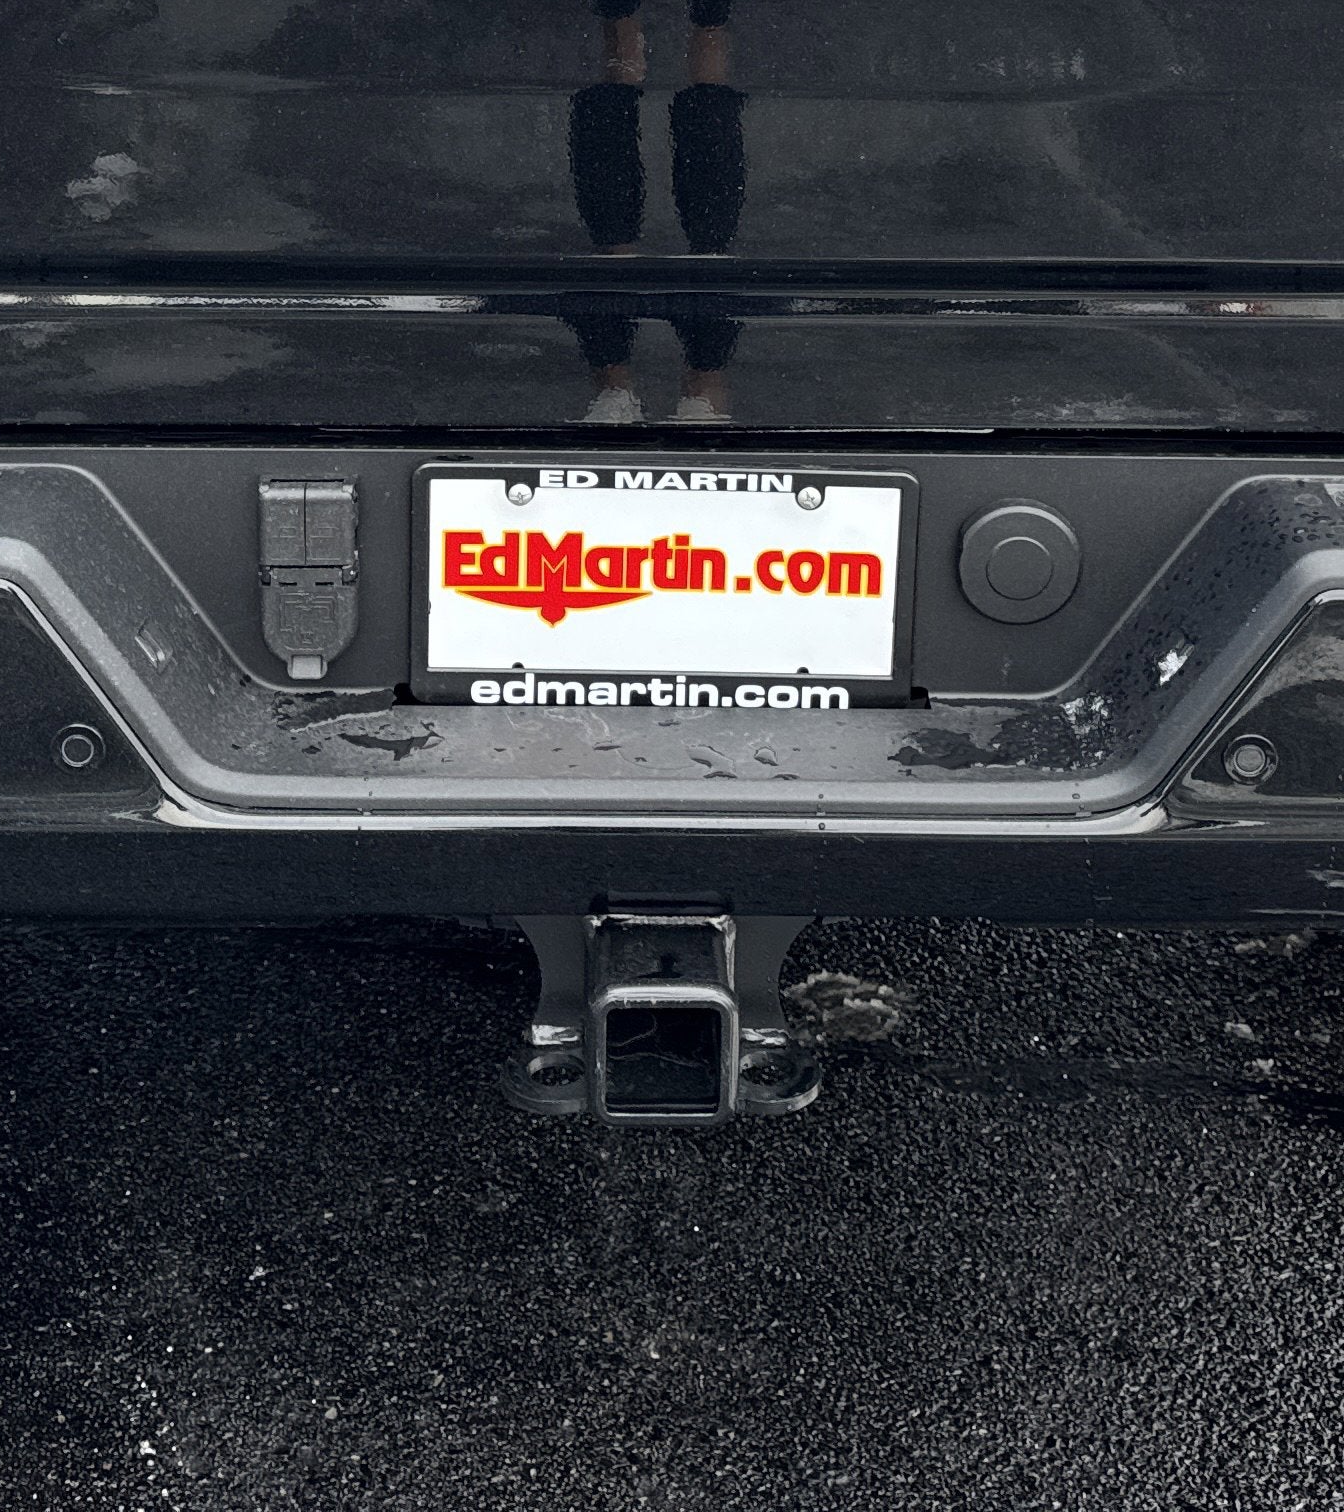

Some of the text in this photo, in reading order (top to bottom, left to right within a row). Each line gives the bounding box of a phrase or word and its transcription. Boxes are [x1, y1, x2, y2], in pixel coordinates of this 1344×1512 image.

[539, 469, 794, 492] ED MARTIN
[442, 529, 882, 598] EdMartin.com
[470, 673, 849, 709] edmartin.com
